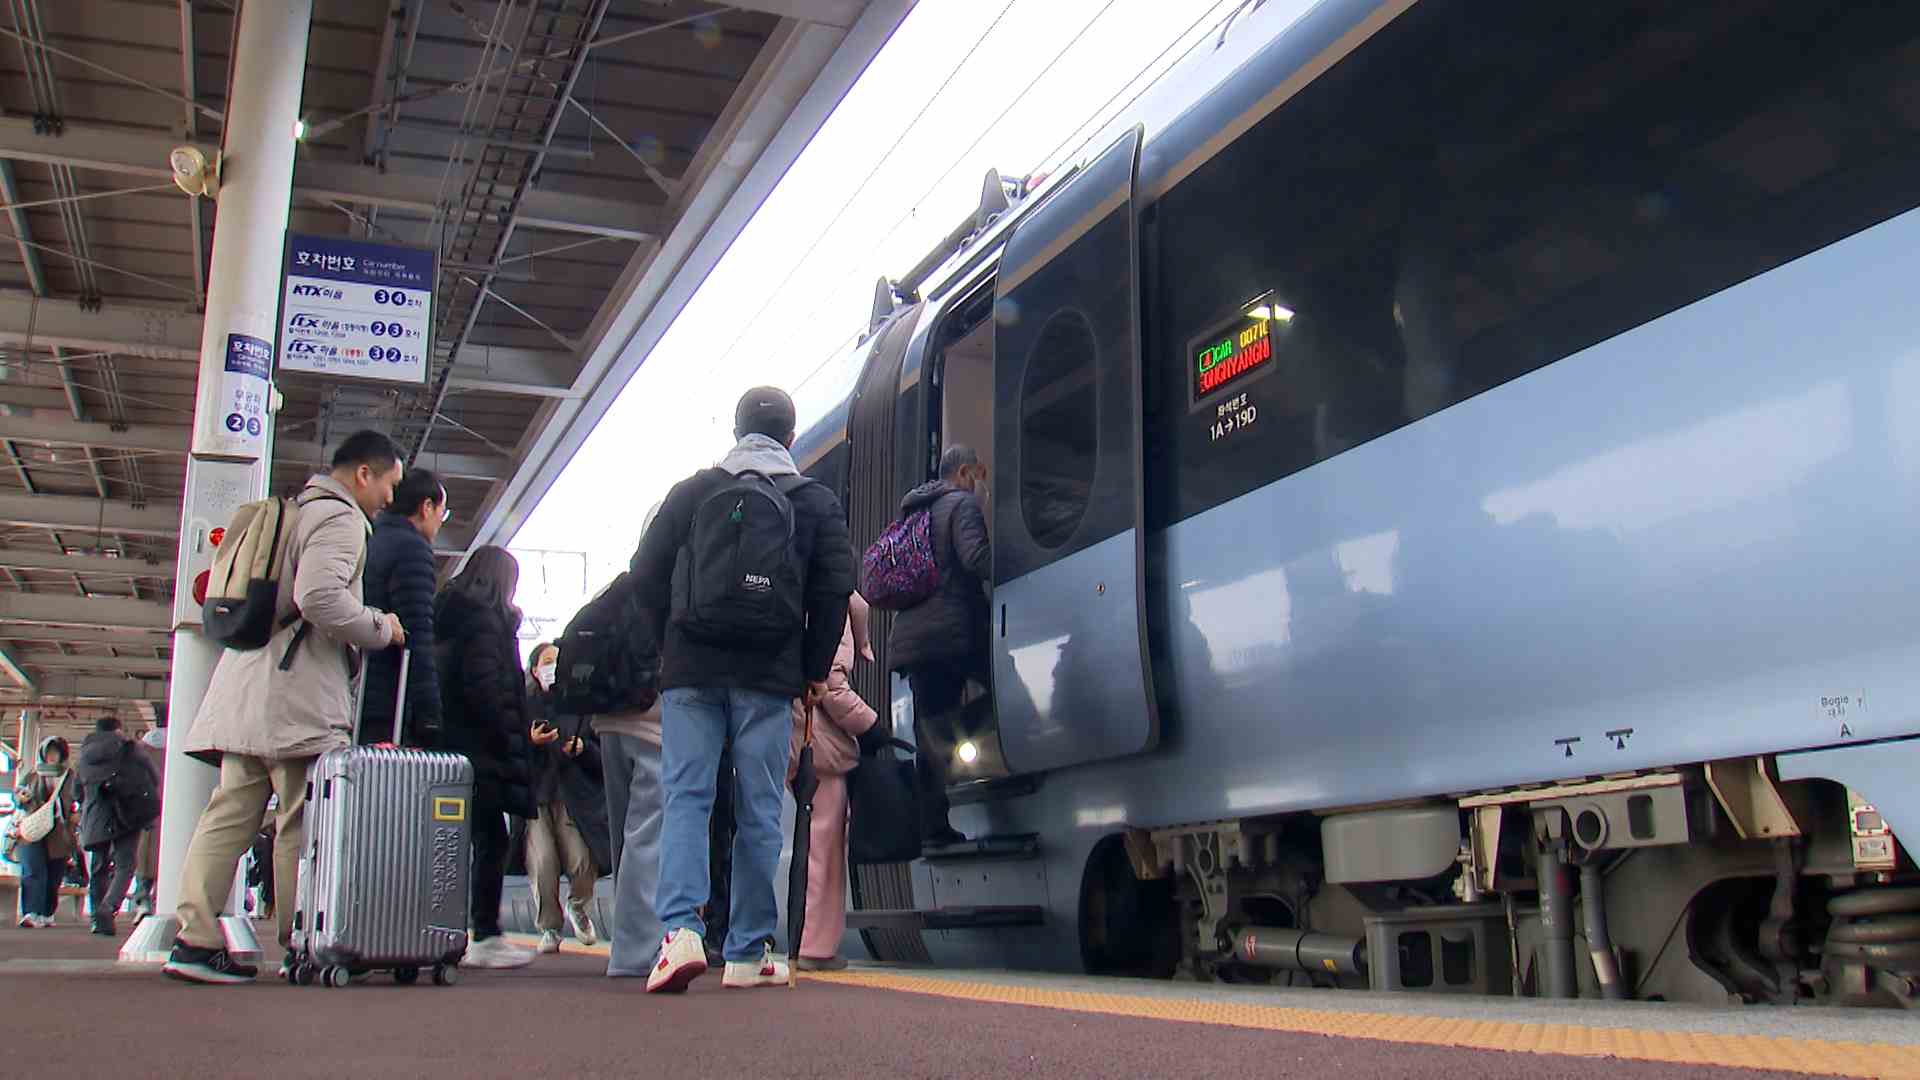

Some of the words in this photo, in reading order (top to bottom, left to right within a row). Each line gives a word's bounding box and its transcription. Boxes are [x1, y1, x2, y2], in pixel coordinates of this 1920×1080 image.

[296, 250, 356, 272] 호차번호
[232, 341, 270, 360] 호차번호
[1213, 338, 1233, 362] CAR
[745, 573, 771, 586] NEPA
[1840, 722, 1852, 738] A
